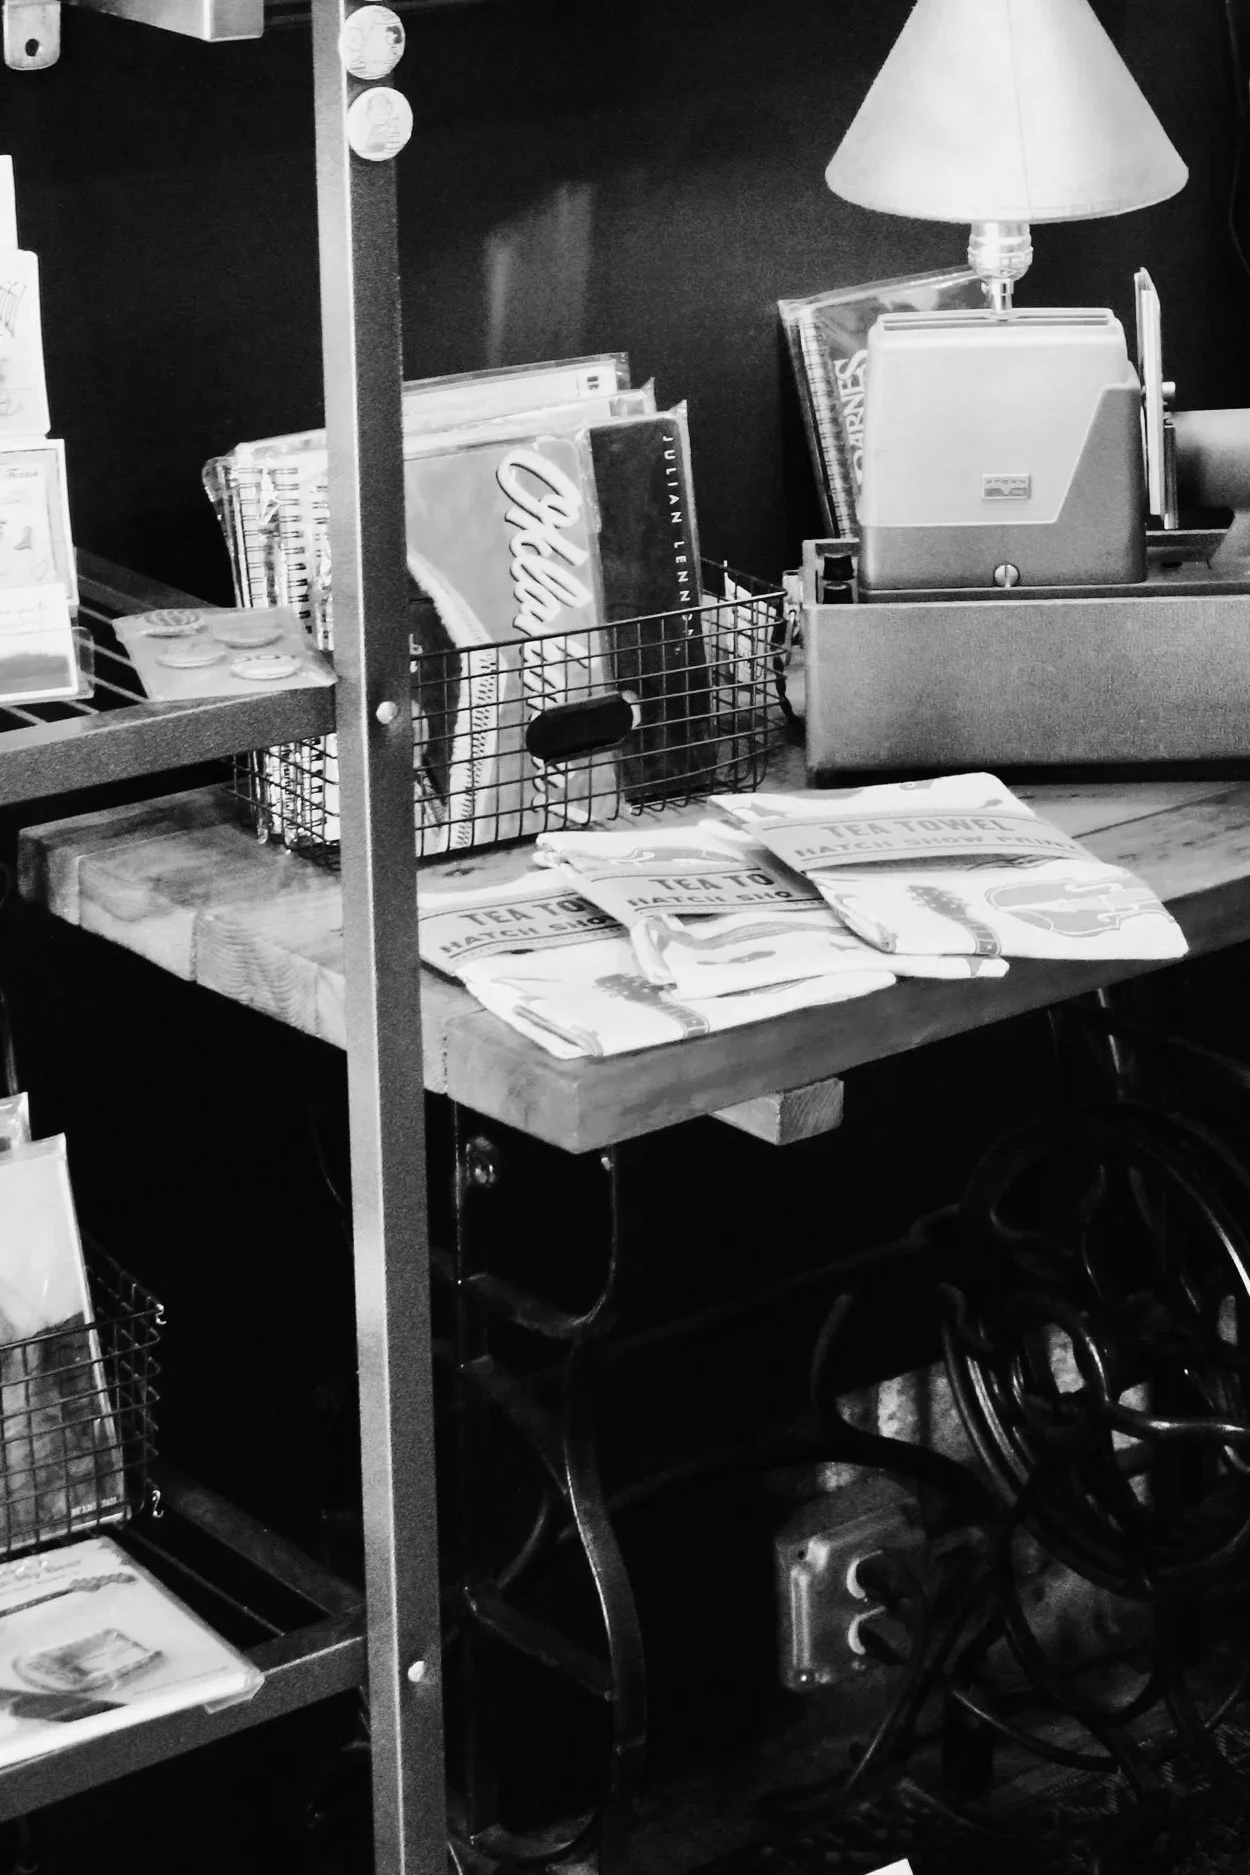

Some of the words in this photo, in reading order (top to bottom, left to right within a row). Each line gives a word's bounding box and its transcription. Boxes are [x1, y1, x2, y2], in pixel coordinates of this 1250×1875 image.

[662, 435, 682, 524] JULIAN
[820, 823, 892, 839] TEA
[894, 818, 1016, 834] TOWEL
[795, 840, 893, 857] HATCH
[903, 835, 984, 845] SHOW
[648, 877, 724, 891] TEA
[721, 873, 775, 887] TO
[626, 895, 727, 907] HATCH
[735, 890, 792, 902] SHO
[458, 908, 535, 926] TEA
[440, 926, 540, 954] HATCH
